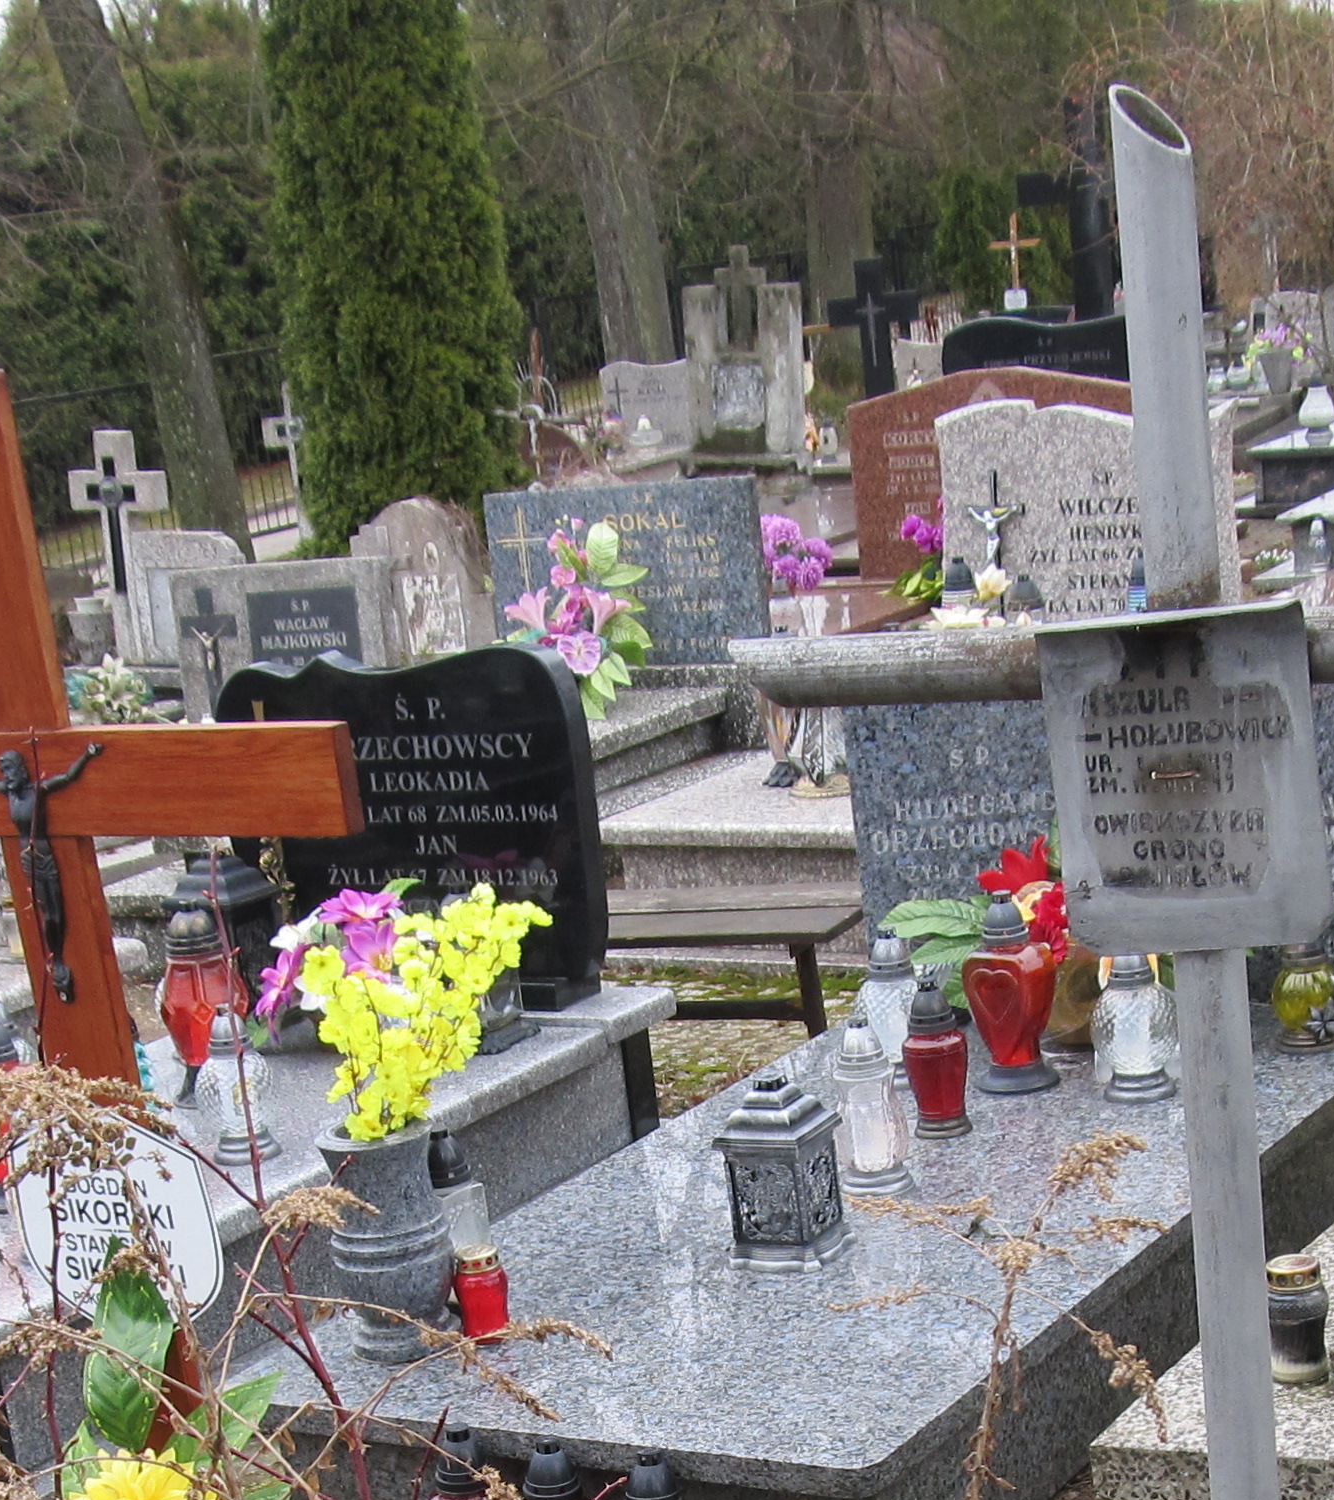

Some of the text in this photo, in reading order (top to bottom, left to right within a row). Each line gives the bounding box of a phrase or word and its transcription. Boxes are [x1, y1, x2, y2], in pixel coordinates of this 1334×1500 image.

[274, 616, 330, 631] WACŁAW
[260, 631, 348, 650] MAJKOWSKI
[370, 770, 490, 792] LEOKADIA
[368, 806, 403, 823] LAT
[408, 806, 427, 823] 68
[415, 834, 458, 856] JAN
[1133, 838, 1225, 861] GRONO
[328, 864, 367, 886] ŻYŁ
[55, 1199, 175, 1230] SIKORKI
